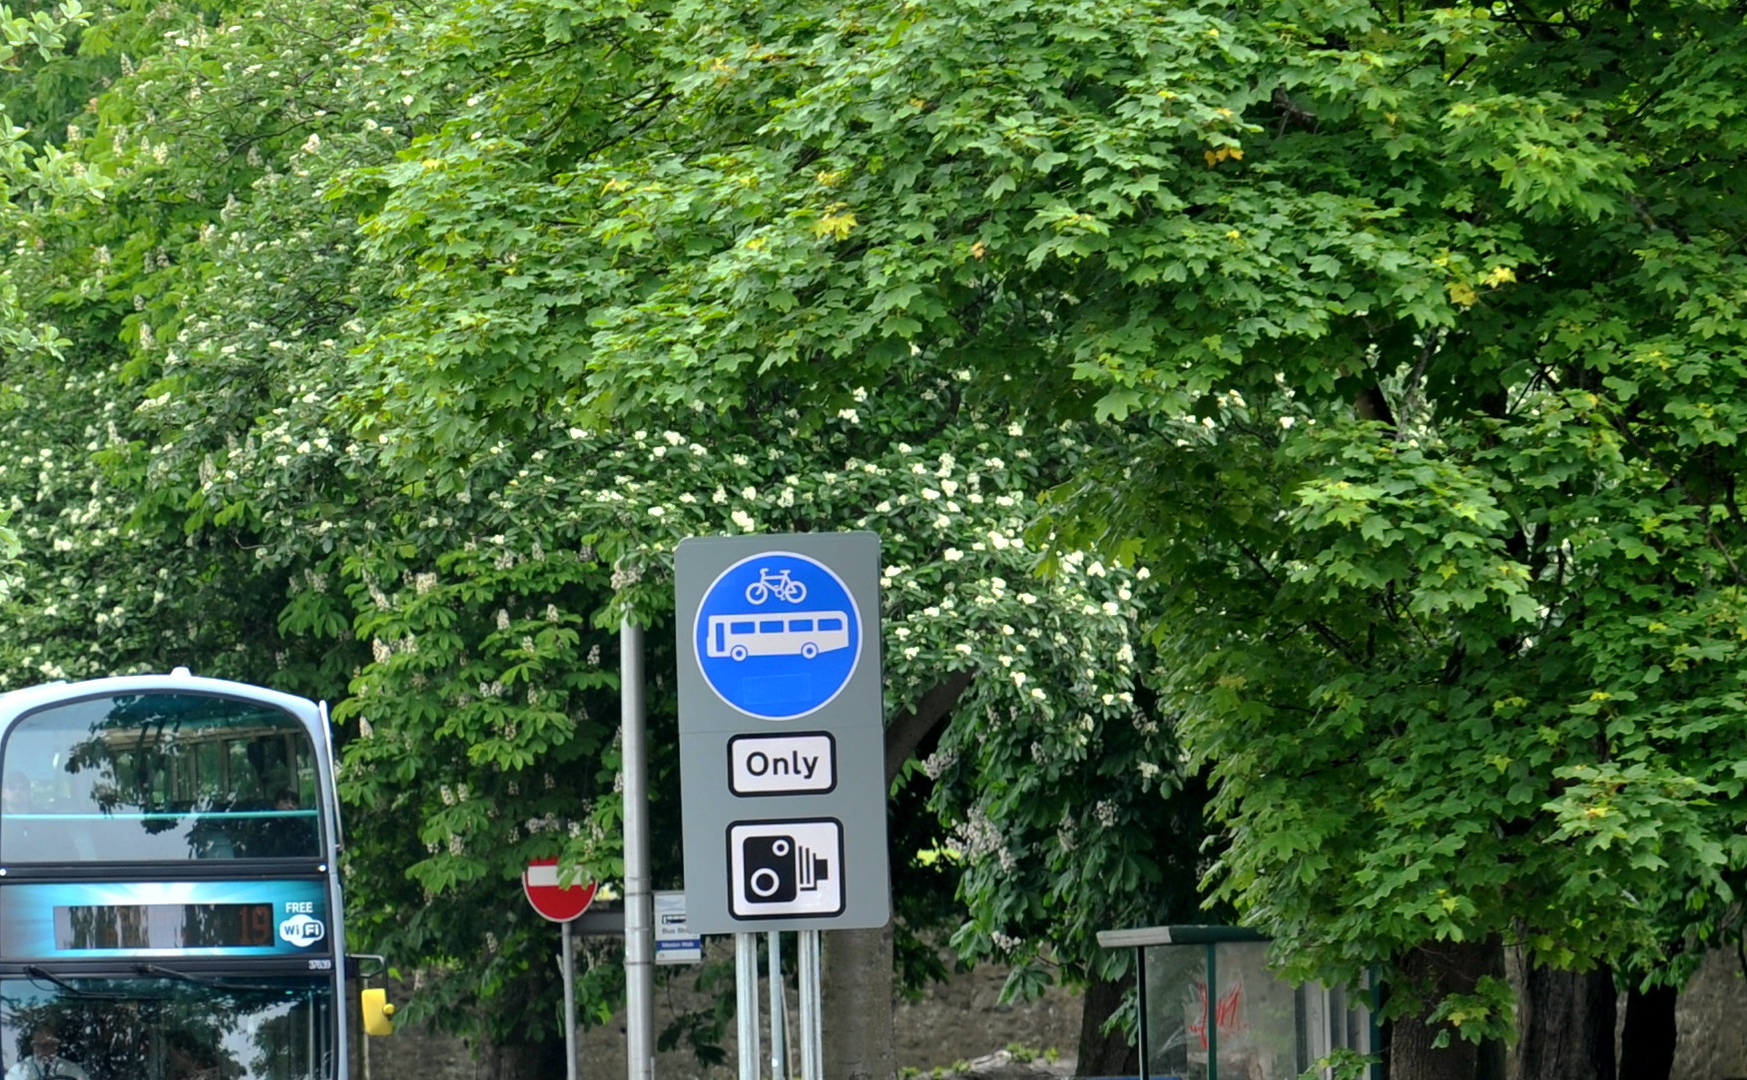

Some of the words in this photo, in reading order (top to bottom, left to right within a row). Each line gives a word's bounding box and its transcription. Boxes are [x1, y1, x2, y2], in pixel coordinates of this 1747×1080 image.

[746, 750, 819, 779] Only
[285, 902, 314, 913] FREE
[239, 905, 271, 945] 19
